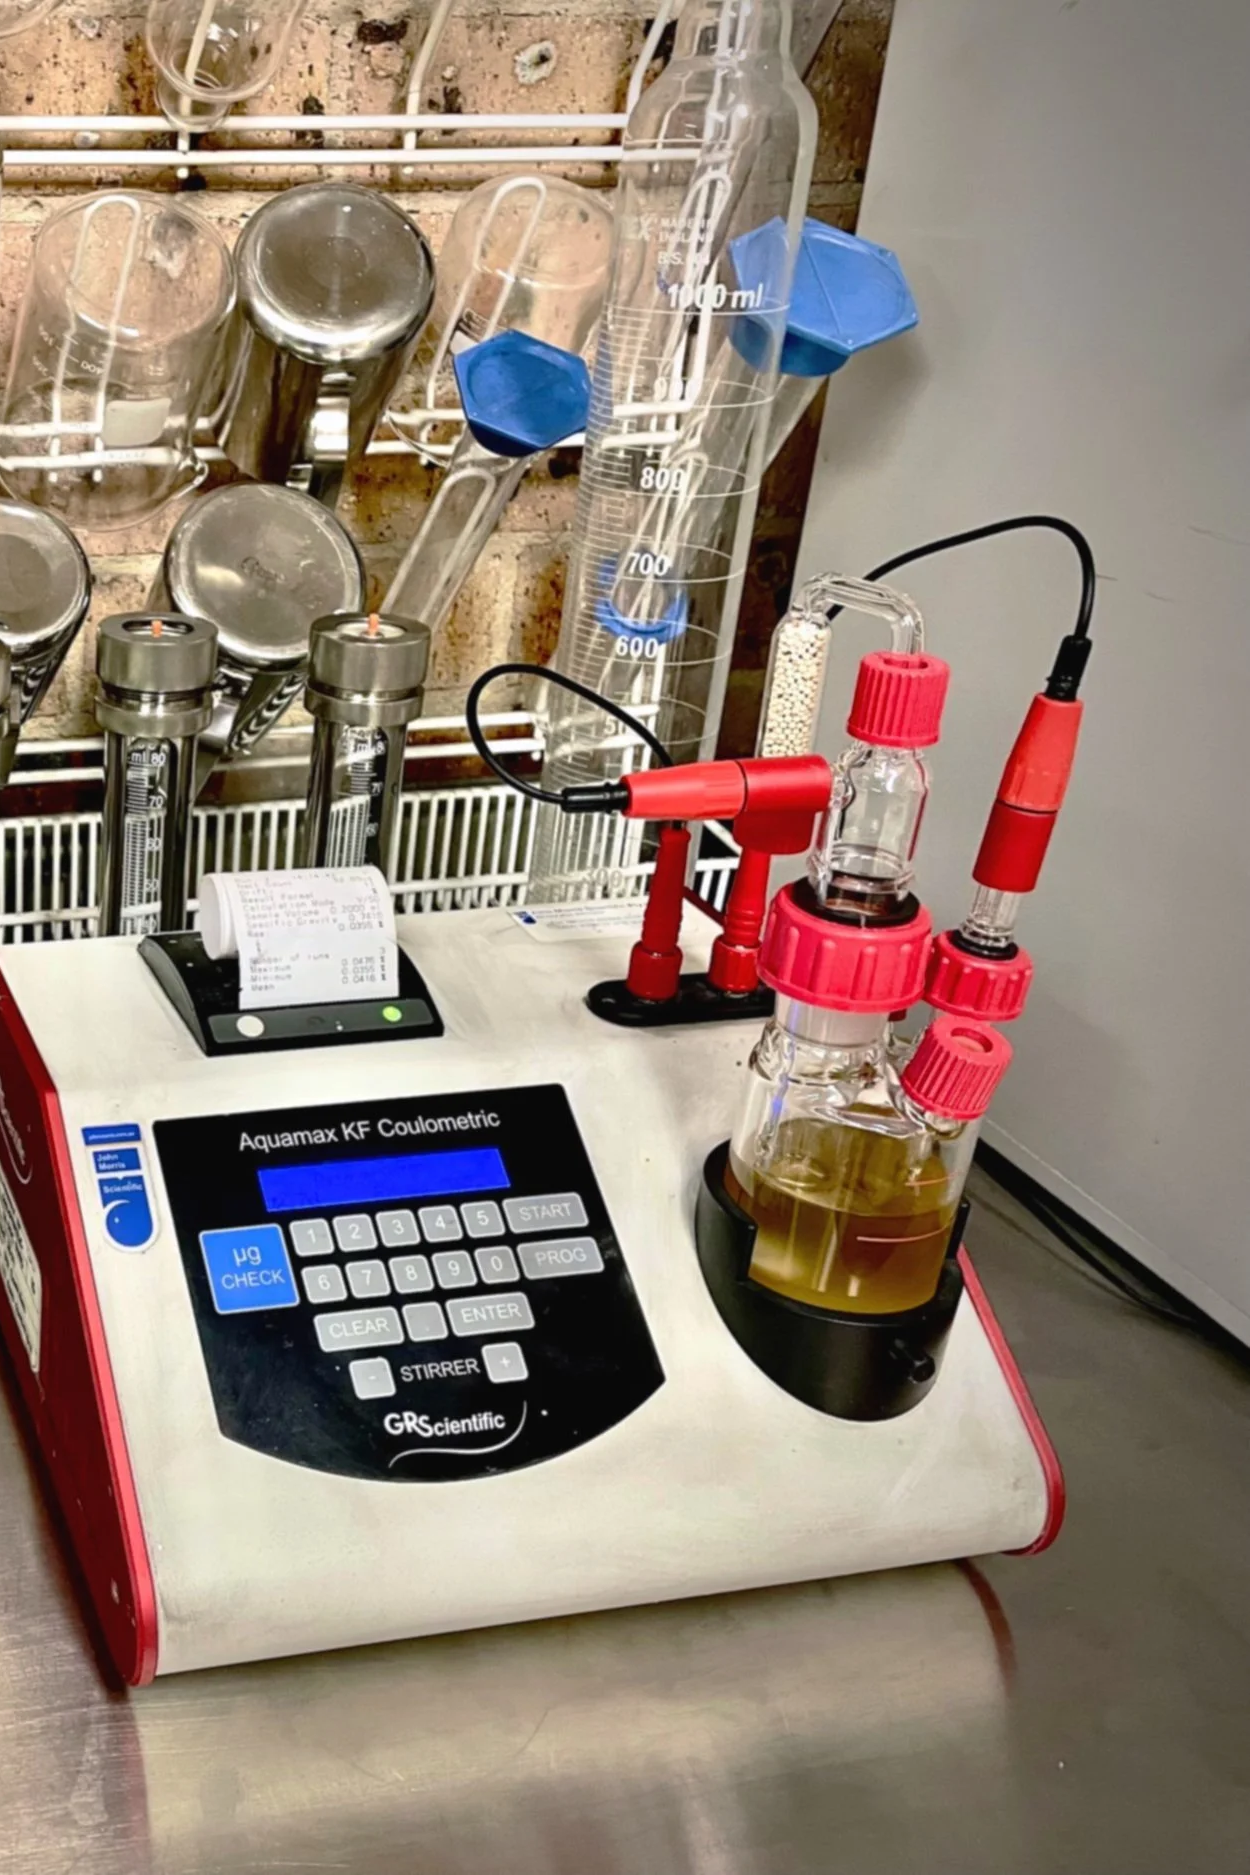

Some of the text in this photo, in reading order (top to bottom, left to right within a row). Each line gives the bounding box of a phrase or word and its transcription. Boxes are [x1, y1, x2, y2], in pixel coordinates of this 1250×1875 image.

[667, 283, 764, 309] 1000 ml
[640, 467, 686, 490] 800
[629, 553, 670, 576] 700
[616, 636, 659, 658] 600
[151, 751, 166, 766] 80
[149, 795, 163, 808] 70
[239, 1109, 501, 1153] Aquamax KF Coulometric
[98, 1162, 126, 1171] Morris
[103, 1180, 143, 1194] Scientific
[307, 1202, 573, 1243] 1 2 3 4 5 START
[221, 1268, 286, 1290] CHECK
[317, 1247, 587, 1290] 6 7 8 9 0 PROG
[329, 1302, 523, 1339] CLEAR ENTER
[400, 1358, 481, 1382] STIRRER
